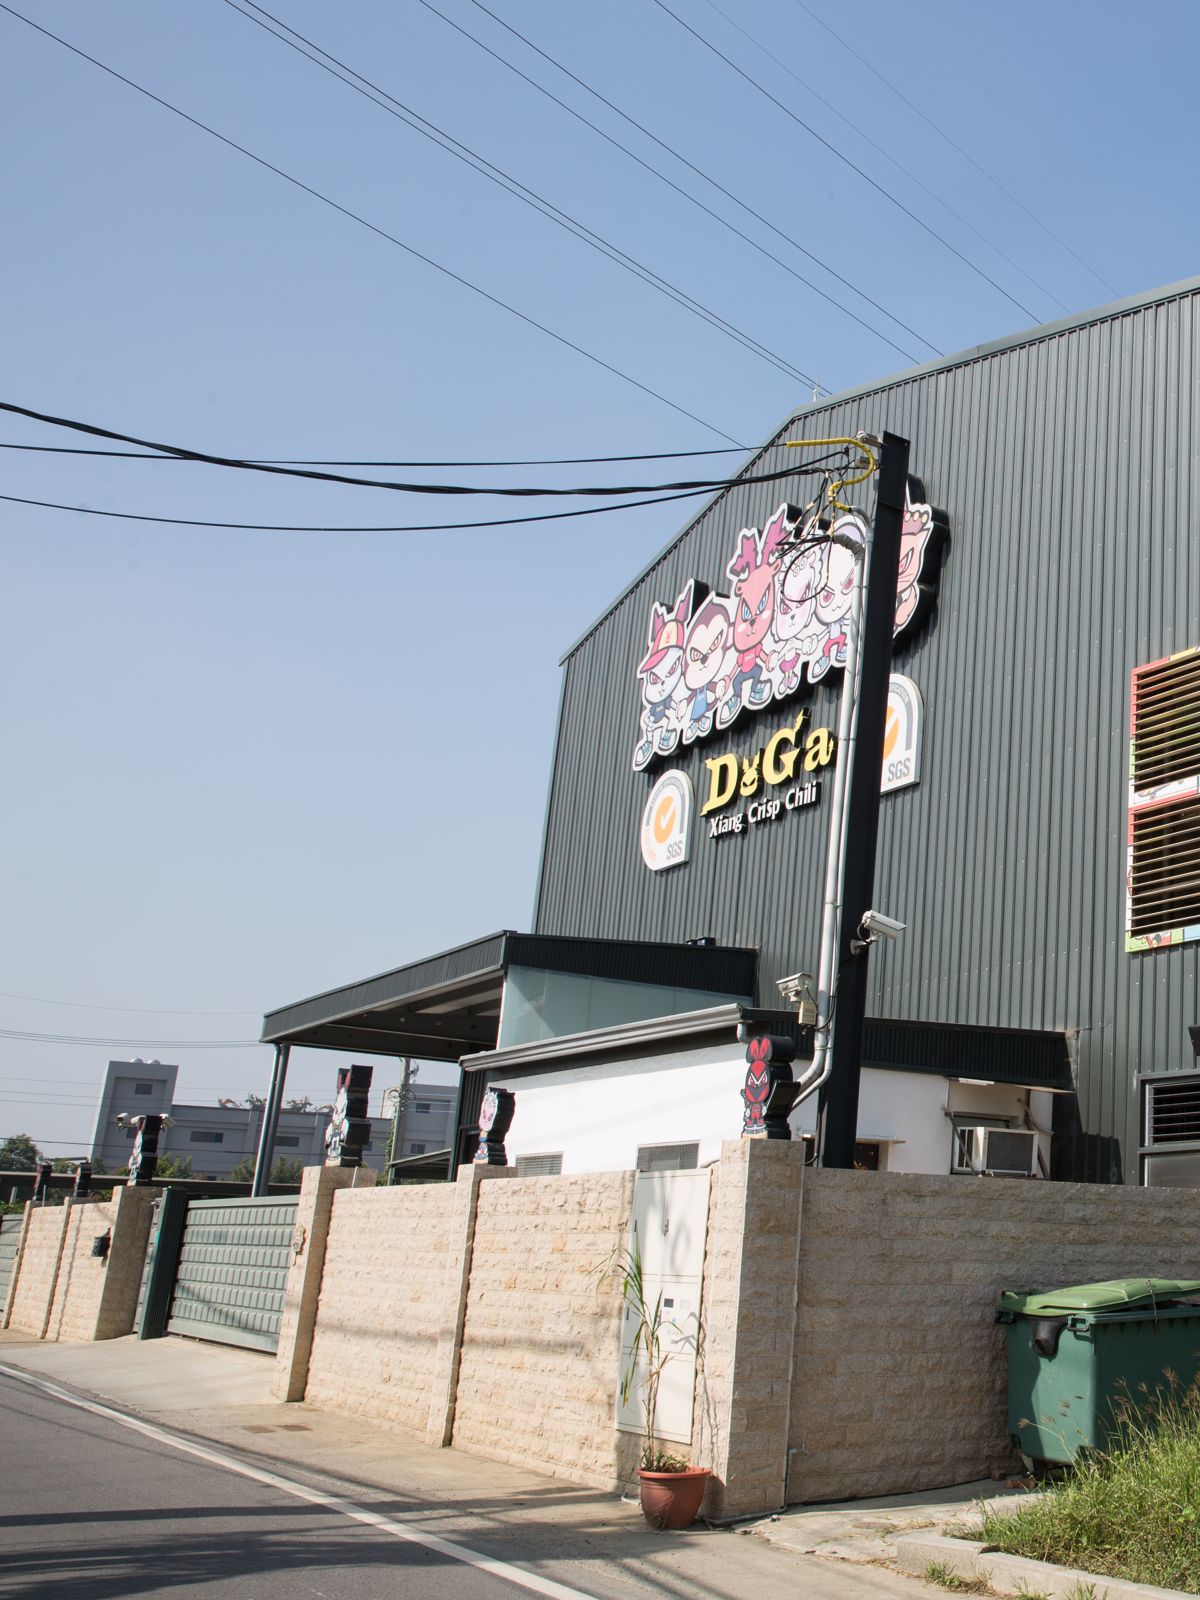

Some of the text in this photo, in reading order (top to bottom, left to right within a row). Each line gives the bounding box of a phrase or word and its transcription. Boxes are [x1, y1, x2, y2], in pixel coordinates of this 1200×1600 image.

[887, 757, 911, 783] SGS
[709, 781, 818, 839] Xiang Crisp Chili
[666, 840, 683, 861] SGS
